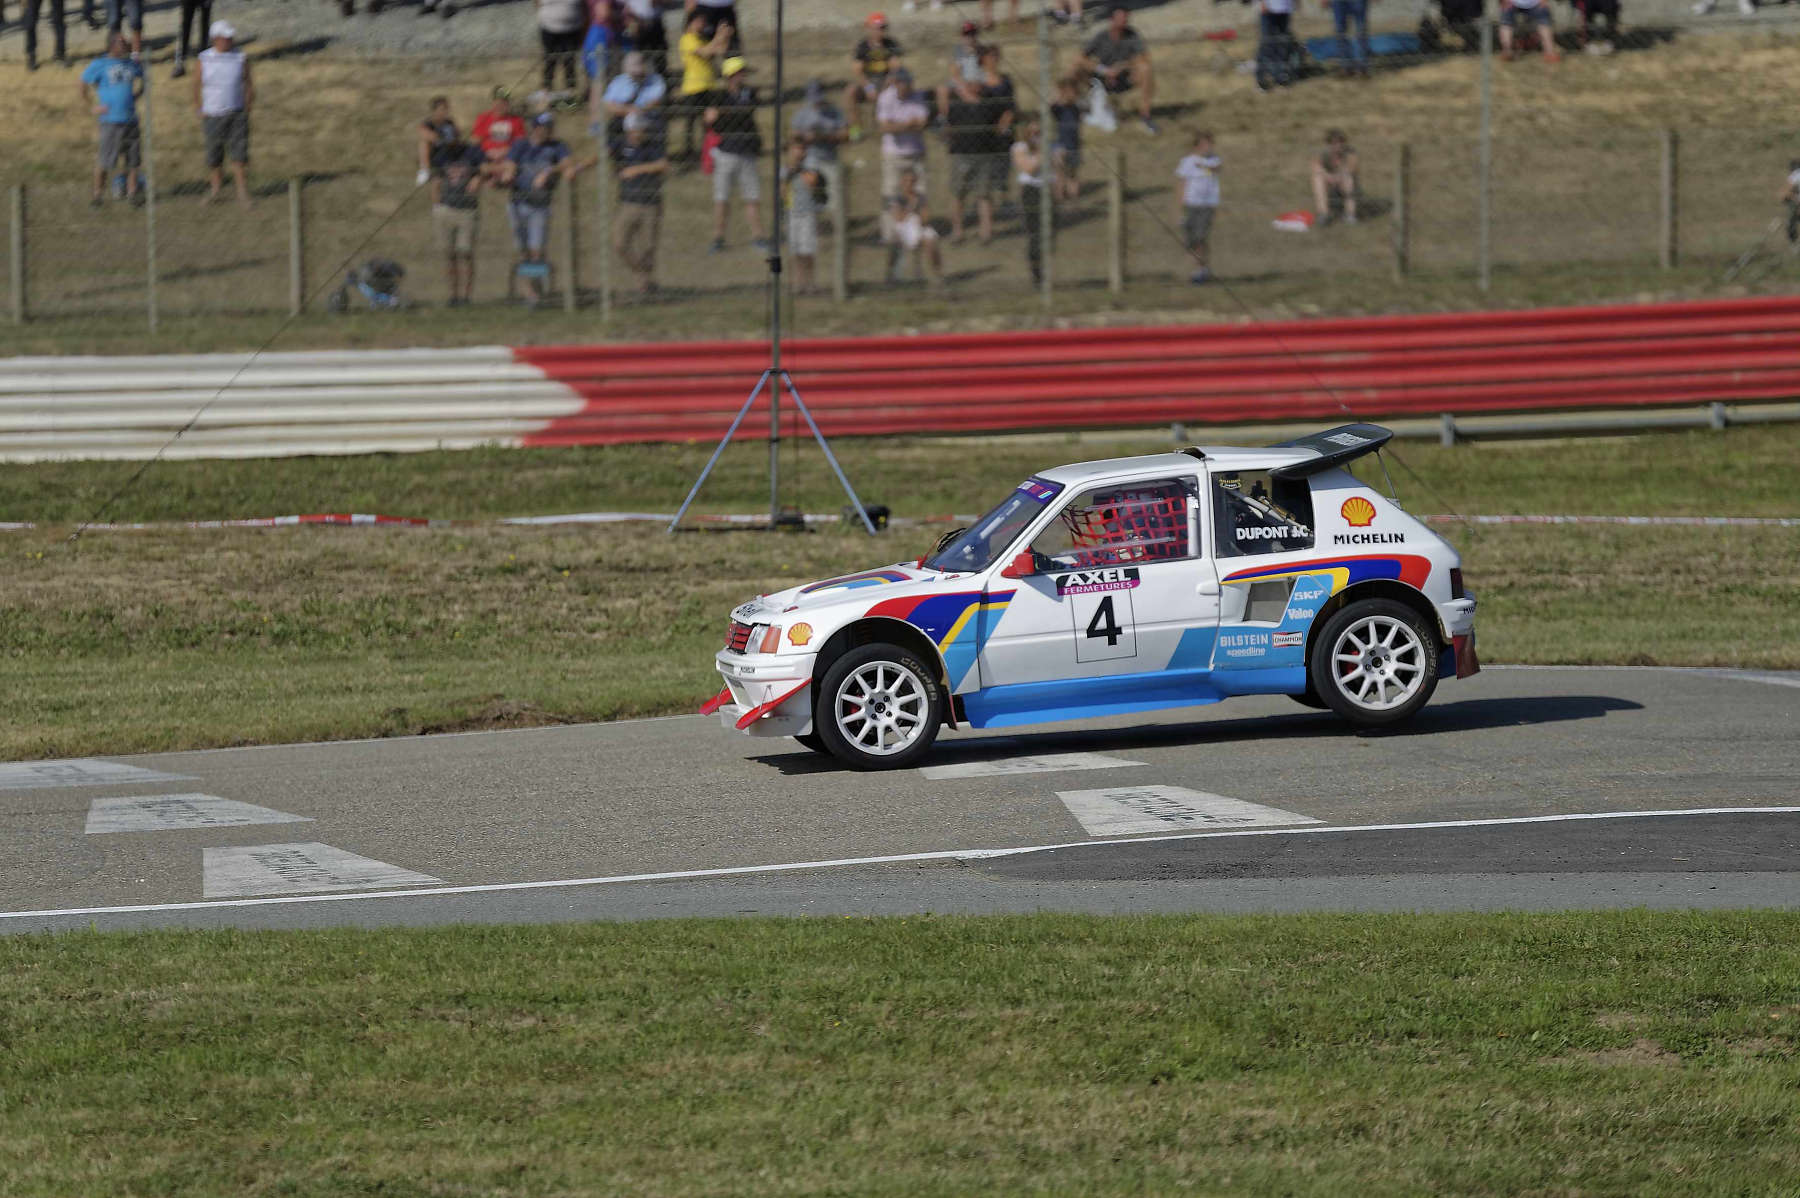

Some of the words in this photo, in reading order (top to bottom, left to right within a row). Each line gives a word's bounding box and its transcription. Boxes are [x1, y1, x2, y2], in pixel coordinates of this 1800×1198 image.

[1236, 526, 1289, 540] DUPONT
[1334, 533, 1405, 545] MICHELIN
[1064, 568, 1132, 588] AXEL
[1063, 582, 1133, 595] FERMETURES
[1294, 590, 1324, 600] SKF
[1086, 595, 1123, 646] 4
[1288, 608, 1314, 620] Valeo
[1220, 633, 1269, 648] BILSTEIN
[1226, 647, 1266, 658] speedline
